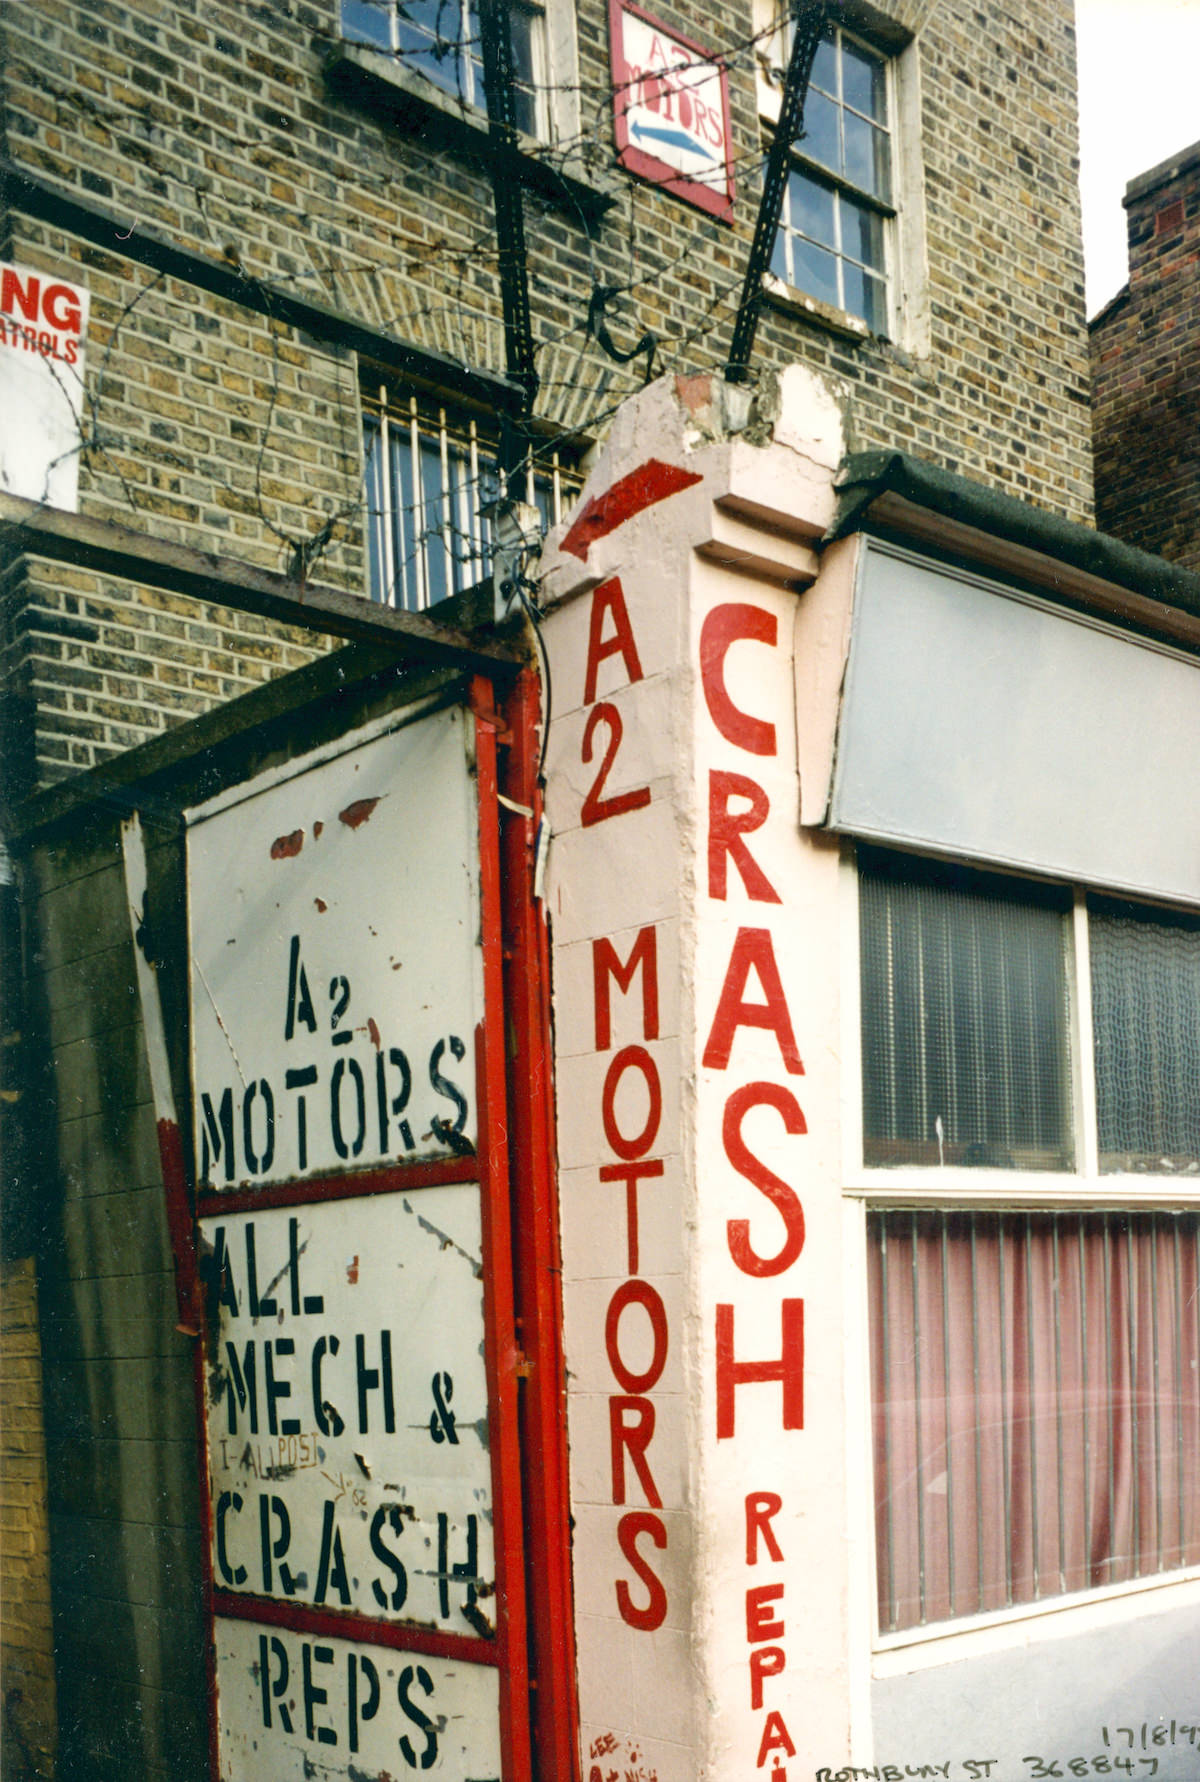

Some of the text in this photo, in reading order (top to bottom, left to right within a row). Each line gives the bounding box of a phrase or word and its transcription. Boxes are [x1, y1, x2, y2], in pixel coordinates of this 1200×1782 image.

[285, 935, 353, 1045] A2
[700, 602, 808, 1441] CRASH
[201, 1035, 474, 1181] MOTORS
[582, 576, 668, 1632] A2 MOTORS
[210, 1217, 324, 1317] ALL
[224, 1330, 459, 1444] MECH &
[216, 1491, 478, 1619] CRASH
[260, 1634, 438, 1770] REPS
